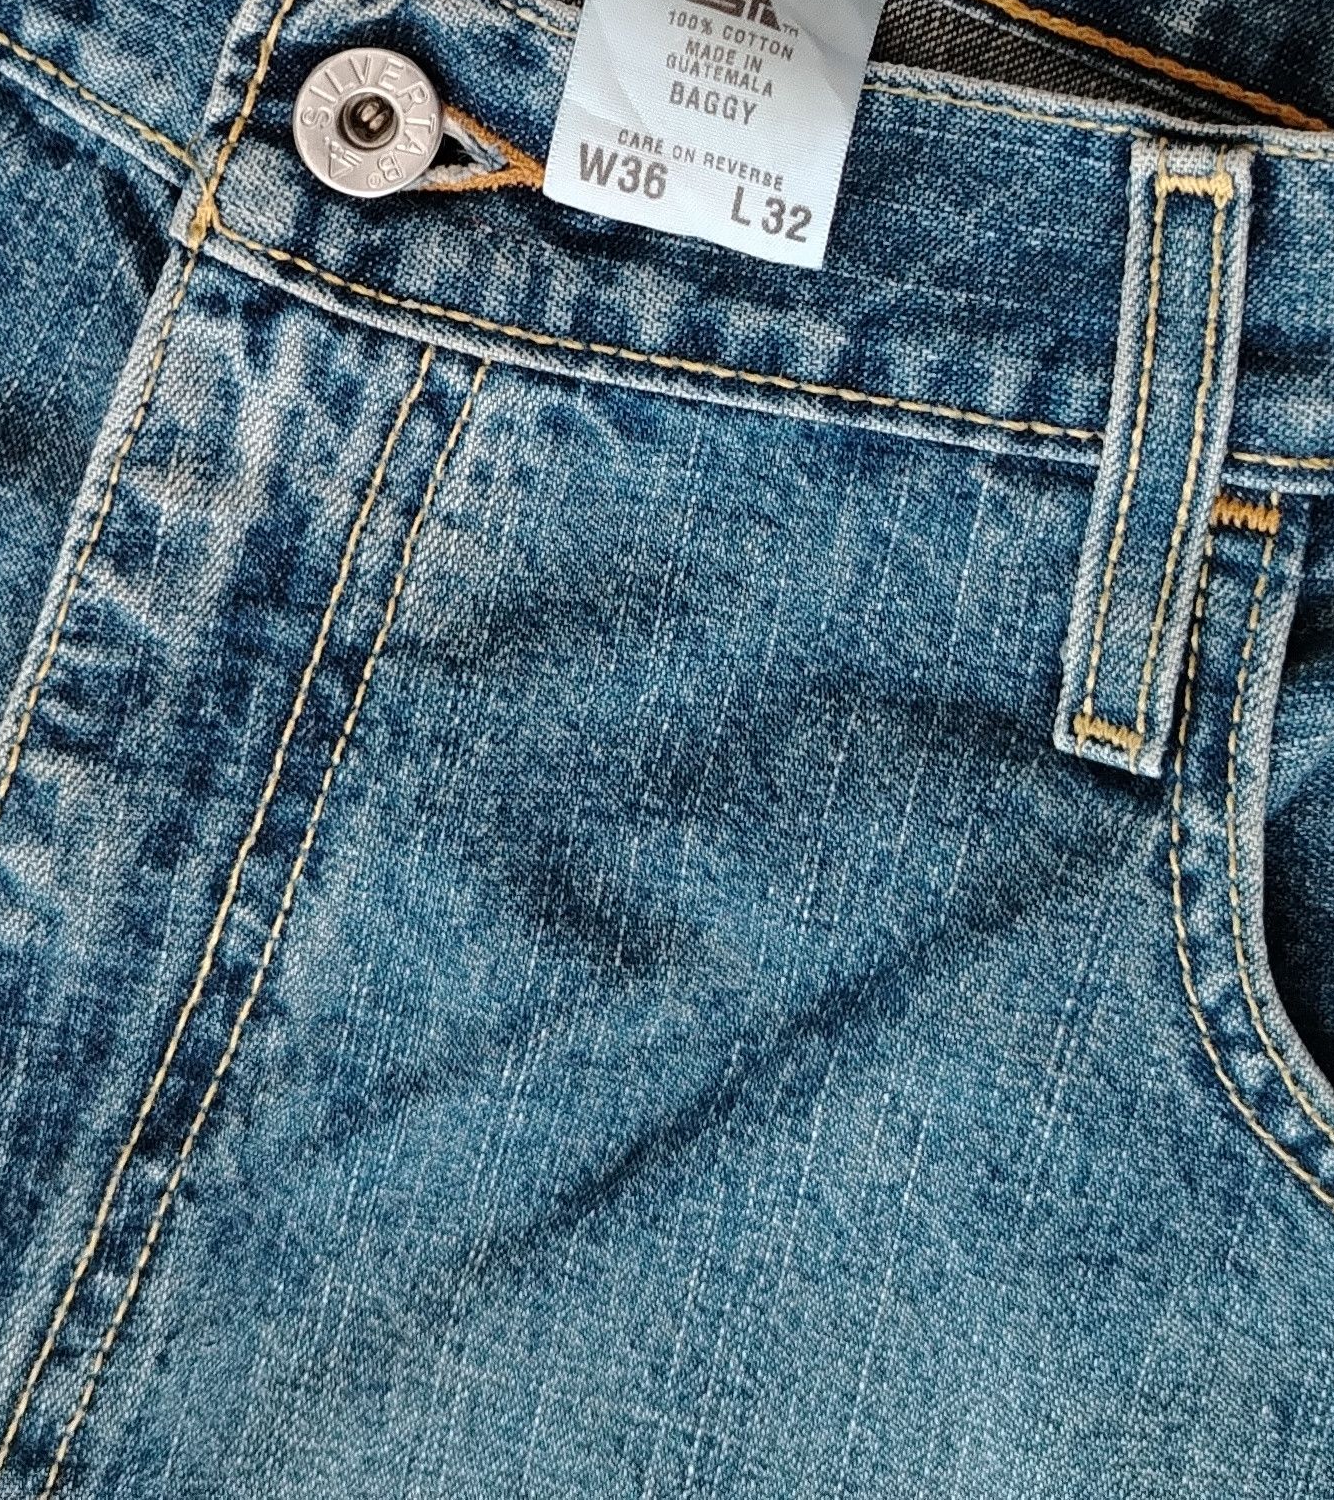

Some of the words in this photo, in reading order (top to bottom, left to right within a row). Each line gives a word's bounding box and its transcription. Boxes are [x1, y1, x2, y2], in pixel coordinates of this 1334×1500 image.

[668, 9, 713, 36] 100%
[723, 25, 794, 61] COTTON
[686, 39, 737, 66] MADE
[743, 54, 763, 74] IN
[666, 52, 773, 98] GUATEMALA
[670, 80, 758, 125] BAGGY
[579, 142, 667, 199] W36
[618, 128, 664, 155] CARE
[672, 144, 696, 164] ON
[703, 151, 784, 192] REVERSE
